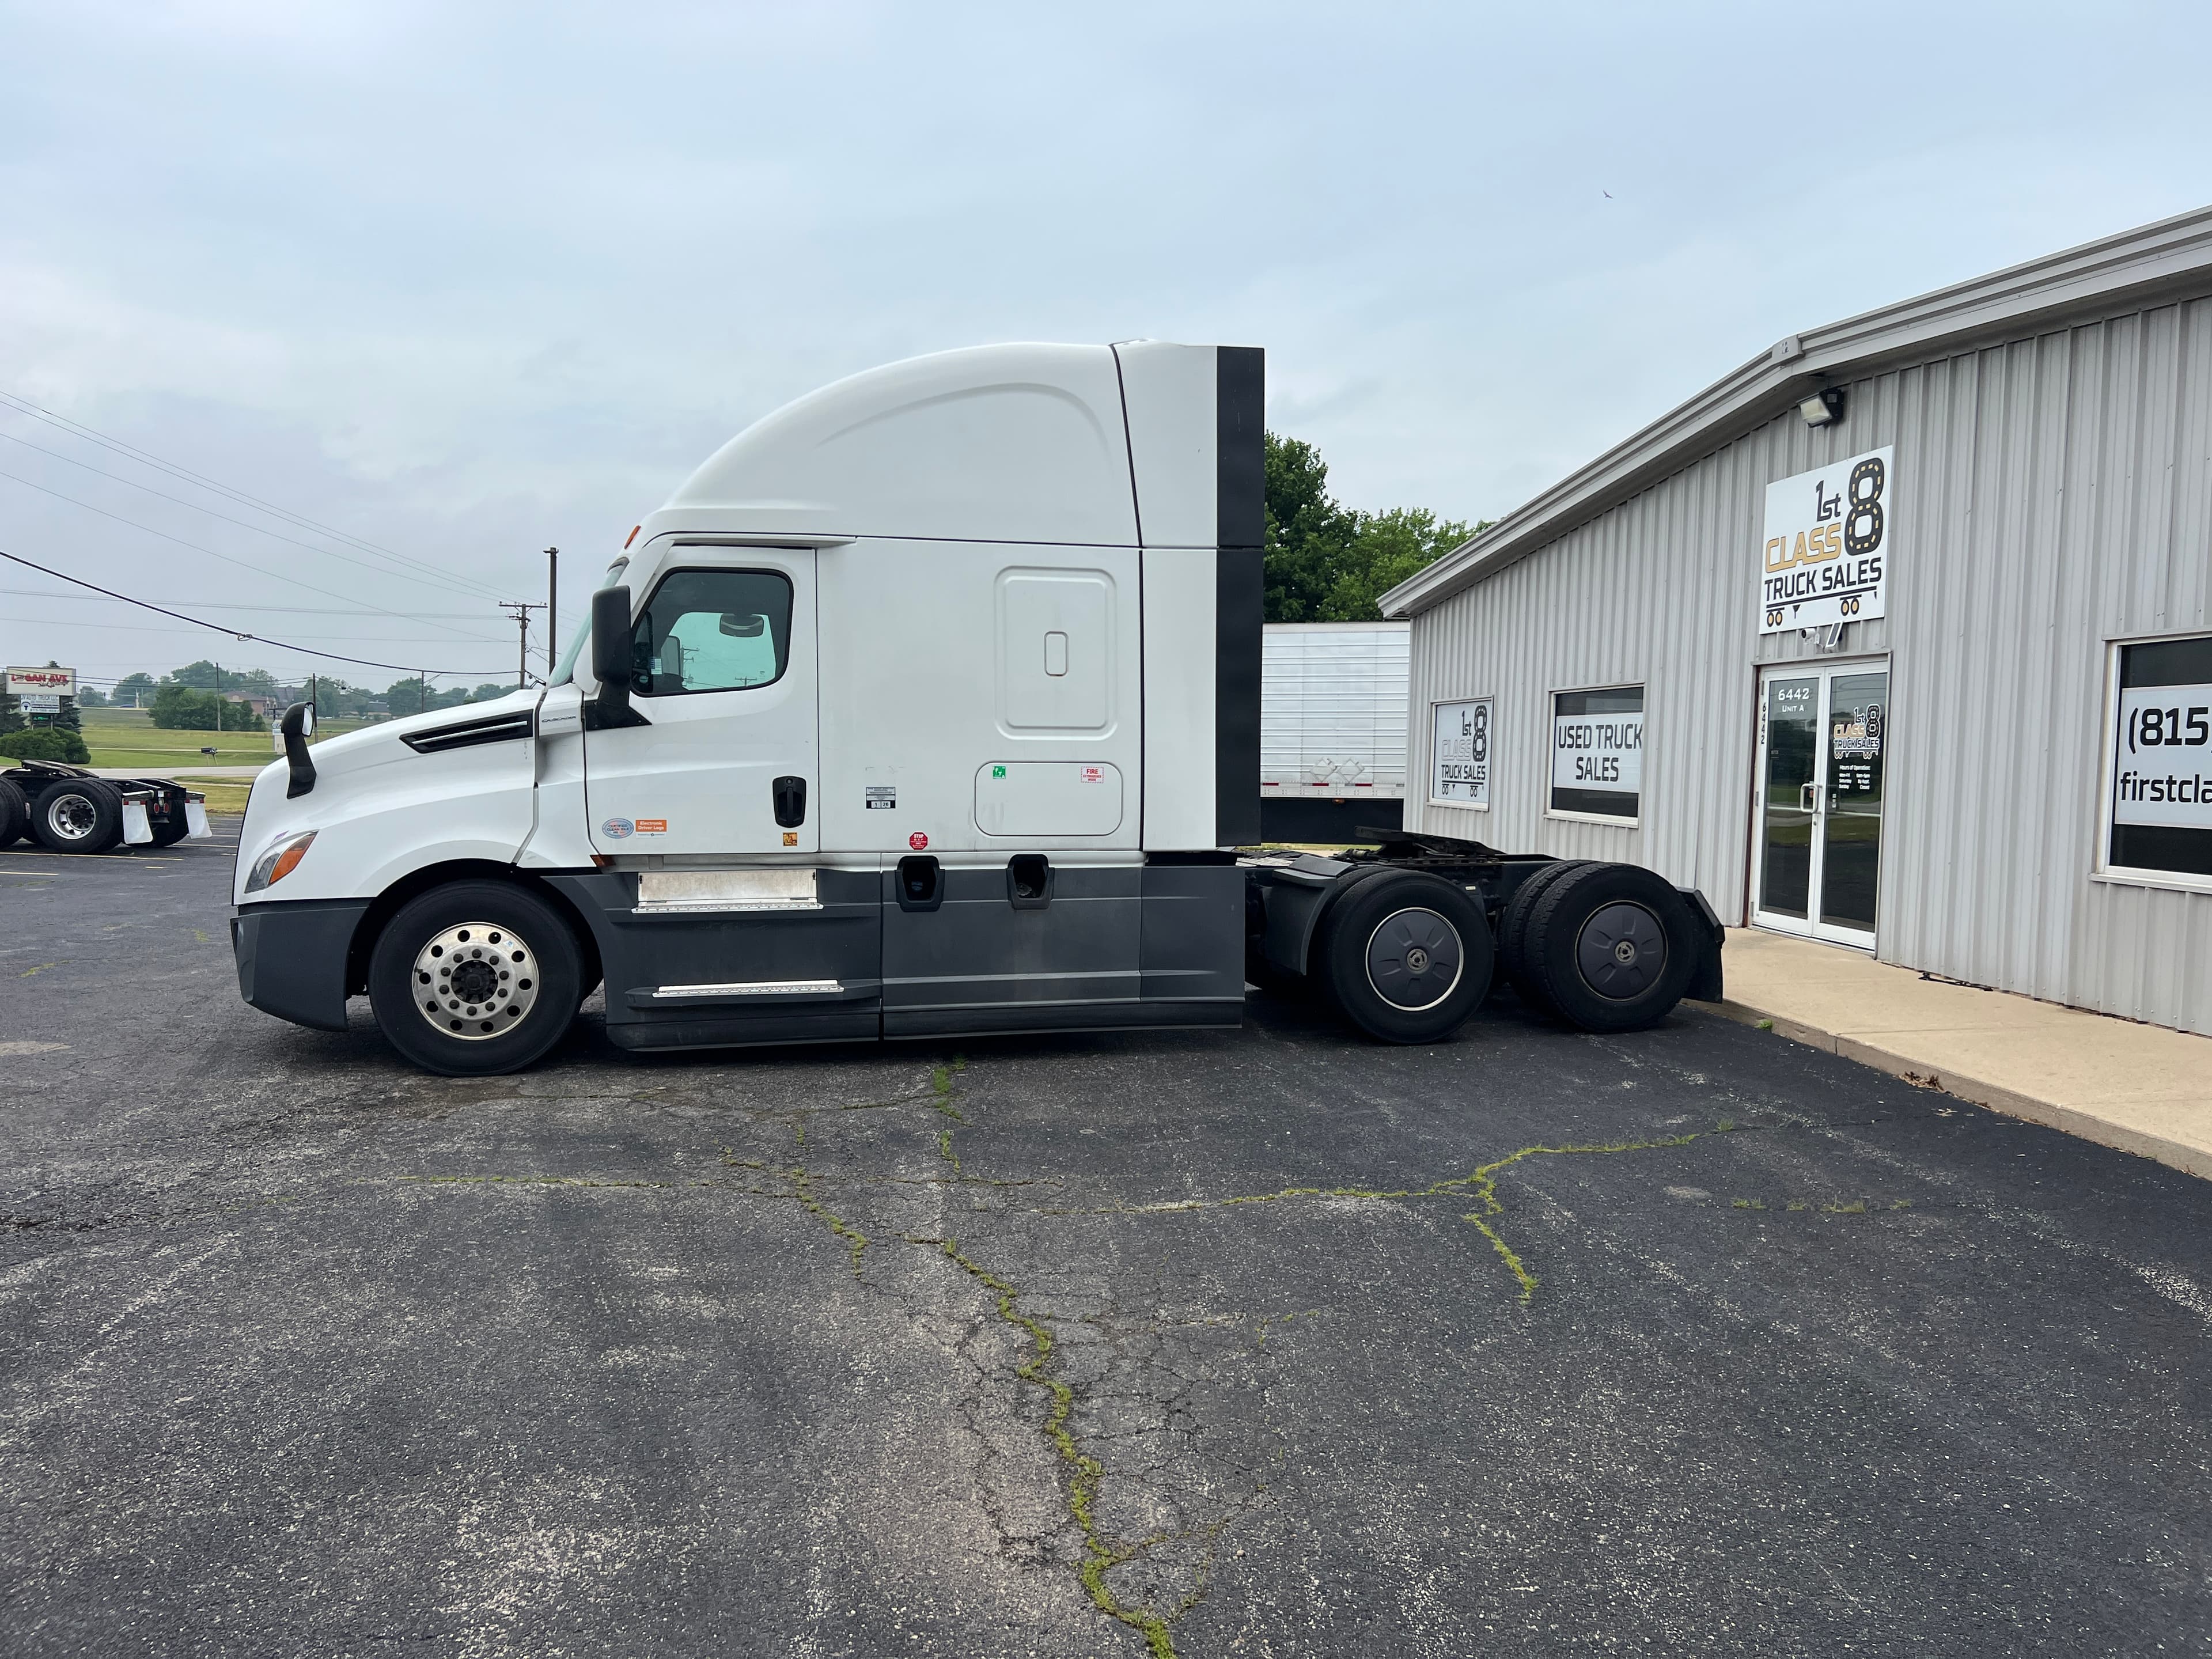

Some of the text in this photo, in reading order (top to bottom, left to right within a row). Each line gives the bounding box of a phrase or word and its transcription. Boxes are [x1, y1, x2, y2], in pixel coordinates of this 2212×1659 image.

[1816, 480, 1841, 522] 1st
[1766, 457, 1884, 573] CLASS 8
[1764, 557, 1881, 601] TRUCK SALES
[1778, 688, 1809, 700] 6442
[1461, 710, 1471, 736] 1st
[1834, 704, 1880, 738] CLASS 8
[1854, 707, 1865, 724] 1st
[1442, 705, 1487, 762] CLASS 8
[1558, 724, 1642, 749] USED TRUCK
[1834, 739, 1880, 748] TRUCK SALES
[2128, 707, 2212, 754] (815
[1441, 764, 1486, 780] TRUCK SALES
[1575, 756, 1619, 782] SALES
